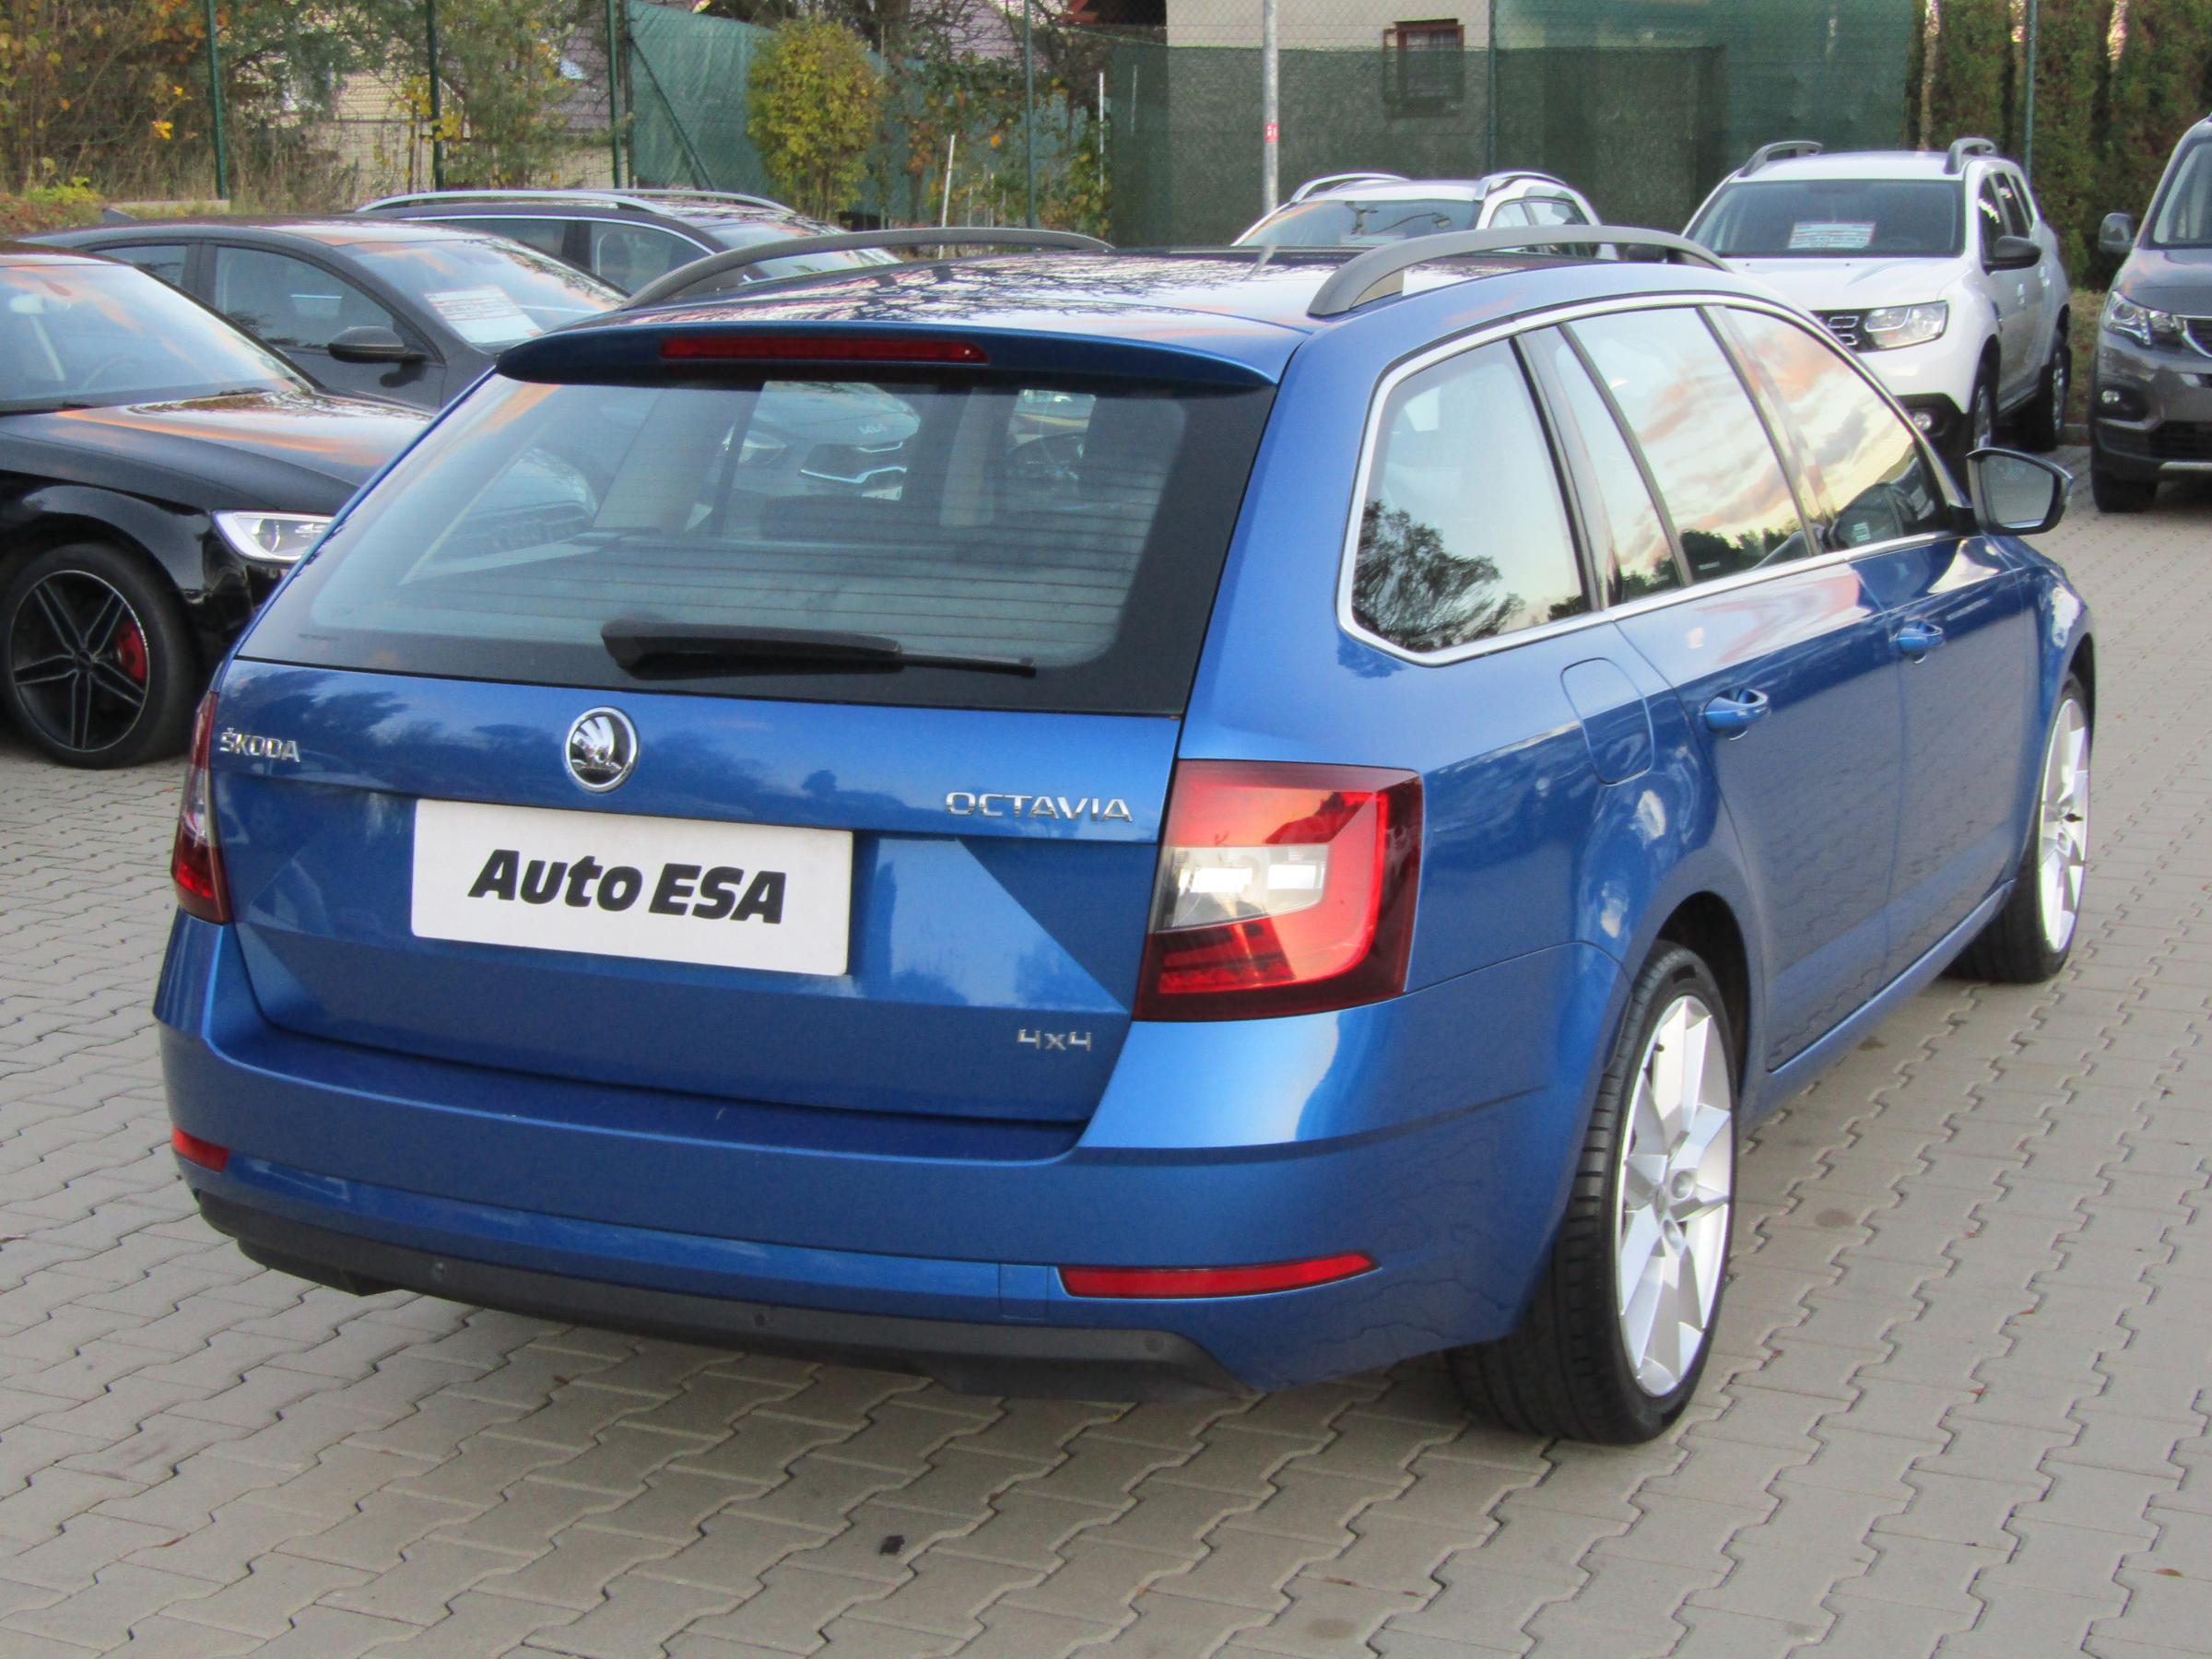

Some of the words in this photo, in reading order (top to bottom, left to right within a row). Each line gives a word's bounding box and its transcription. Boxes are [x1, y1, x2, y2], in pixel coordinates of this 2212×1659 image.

[219, 727, 300, 763] ŠKODA
[946, 791, 1133, 821] OCTAVIA
[467, 849, 642, 912] Auto
[649, 863, 787, 925] ESA
